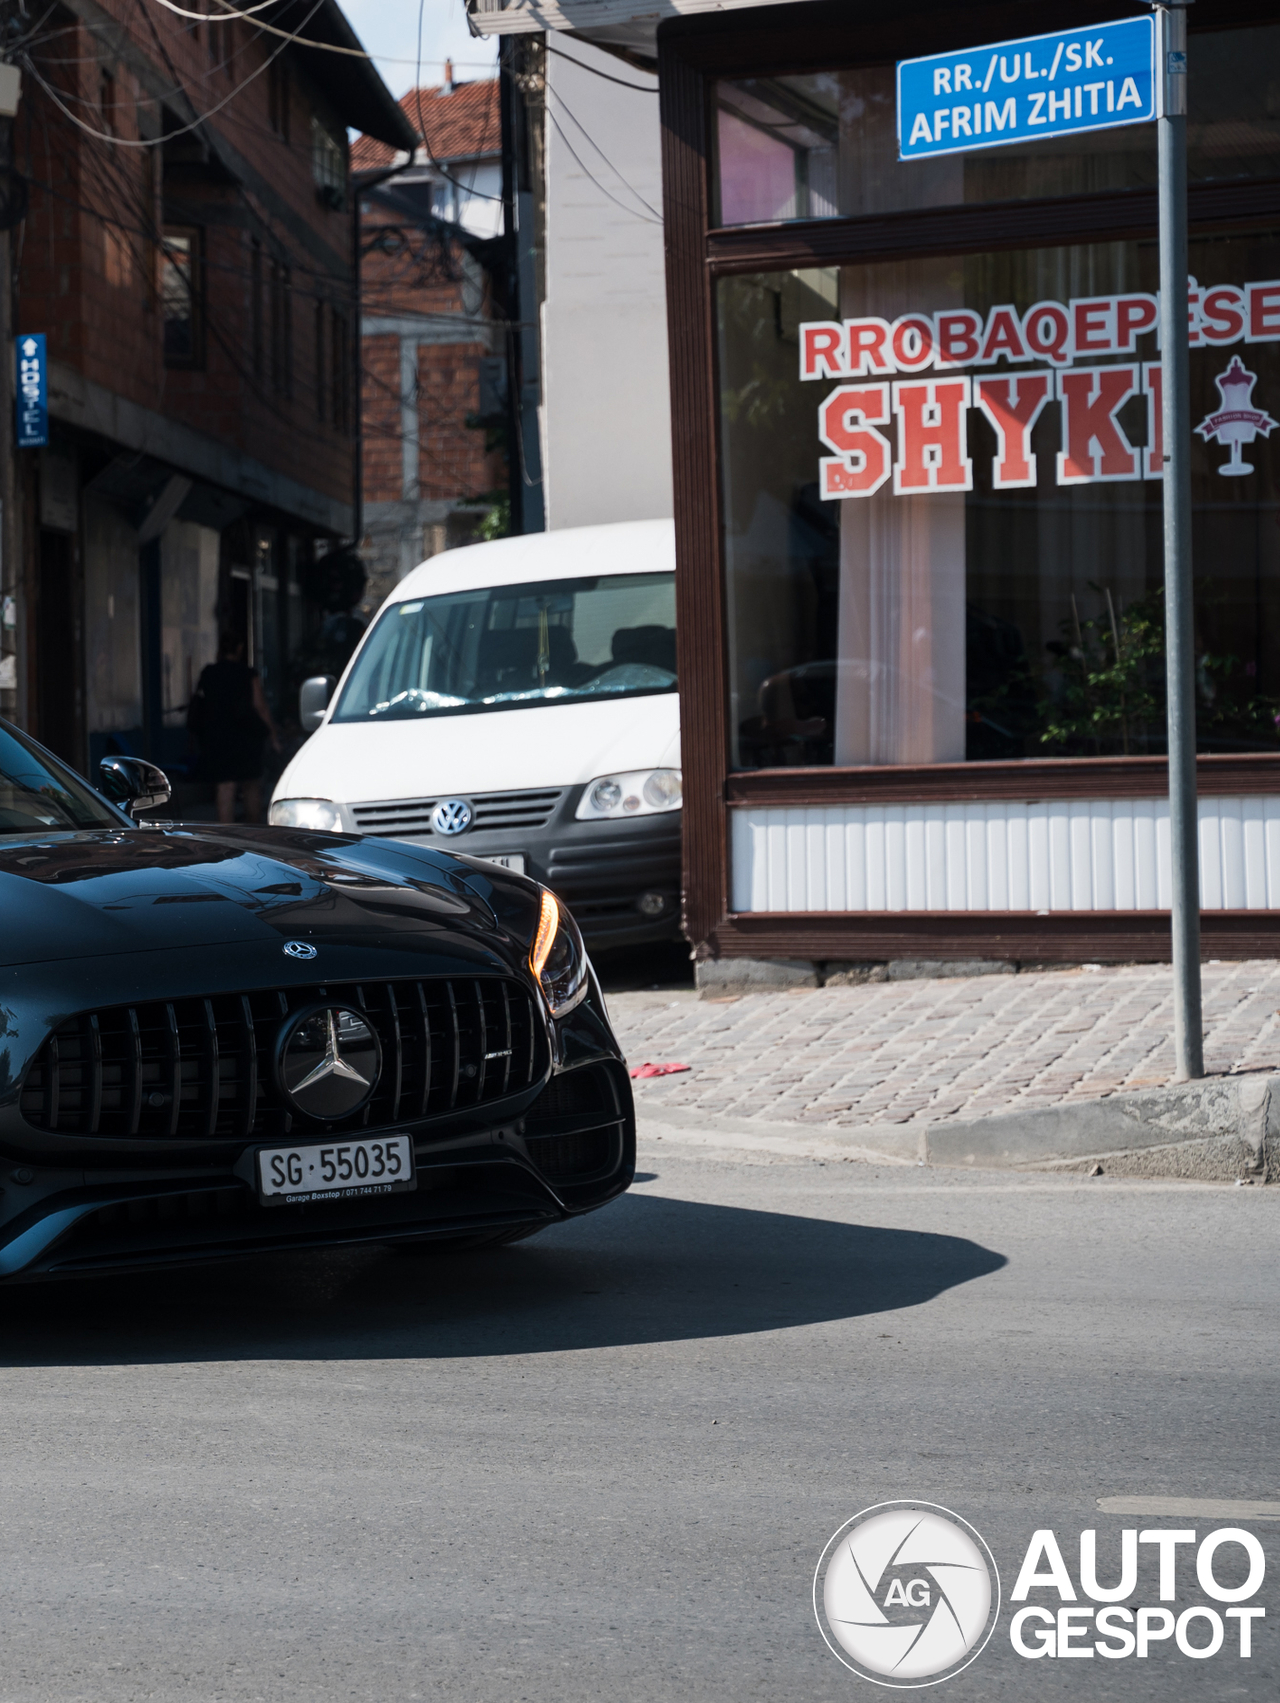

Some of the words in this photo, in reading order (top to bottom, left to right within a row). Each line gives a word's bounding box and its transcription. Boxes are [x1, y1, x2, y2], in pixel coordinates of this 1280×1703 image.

[933, 38, 1114, 96] RR./UL./SK.
[908, 97, 1017, 146] AFRIM
[1026, 76, 1143, 126] ZHITIA
[800, 276, 1280, 379] RROBAQEPSE
[20, 358, 41, 436] HOSTEL
[286, 1193, 310, 1203] Garage
[311, 1190, 340, 1200] Boxstop
[346, 1188, 358, 1197] 071
[383, 1184, 392, 1192] 79
